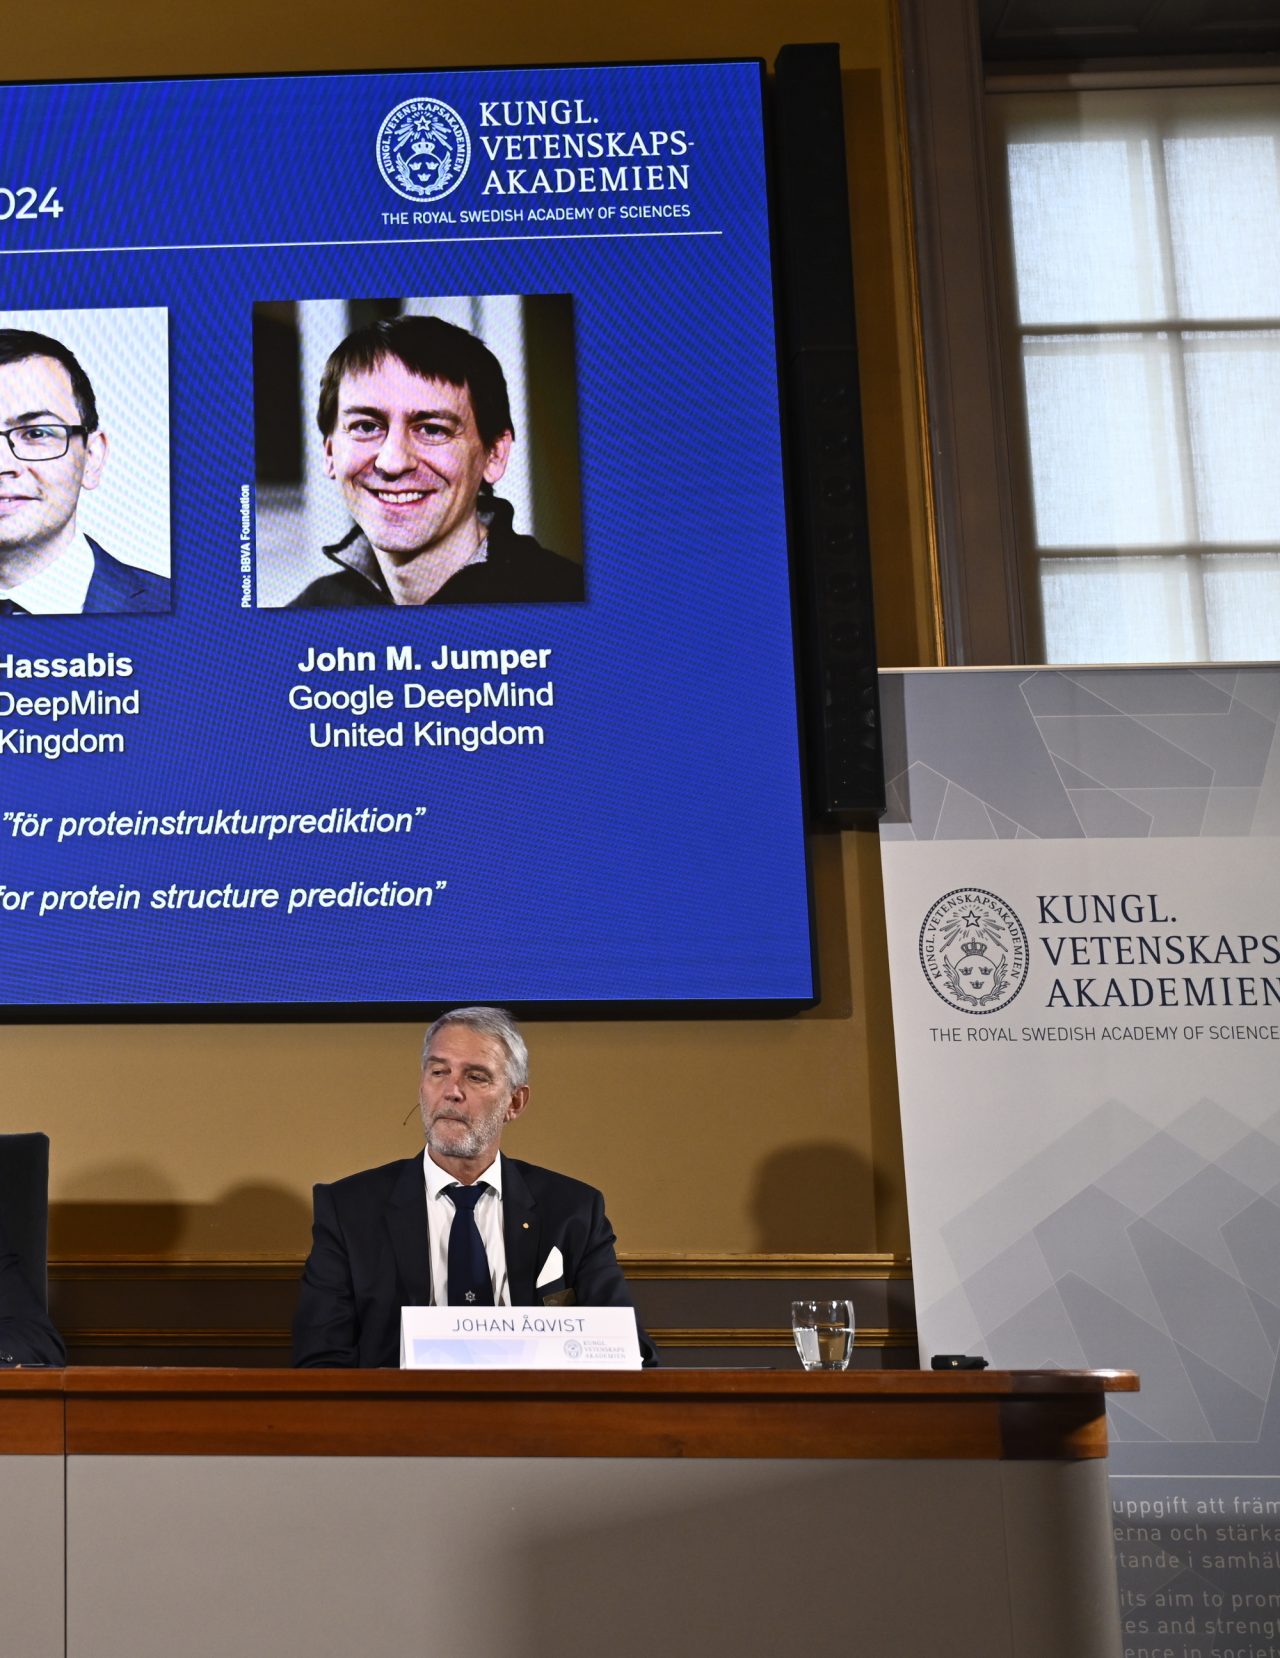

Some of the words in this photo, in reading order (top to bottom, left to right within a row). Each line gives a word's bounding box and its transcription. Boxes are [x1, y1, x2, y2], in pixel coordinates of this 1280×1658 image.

[480, 100, 598, 126] KUNGL.
[382, 134, 396, 174] KUNGL.
[480, 131, 694, 160] VETENSKAPS-
[482, 165, 689, 194] AKADEMIEN
[382, 213, 408, 224] THE
[414, 212, 456, 223] ROYAL
[460, 210, 523, 222] SWEDISH
[528, 208, 594, 220] ACADEMY
[598, 207, 615, 219] OF
[620, 205, 690, 218] SCIENCES
[240, 484, 250, 540] Foundation
[241, 542, 251, 572] BBVA
[241, 575, 251, 608] Photo:
[298, 647, 375, 672] John
[387, 646, 421, 670] M.
[432, 646, 551, 673] Jumper
[289, 685, 393, 714] Google
[405, 682, 553, 713] DeepMind
[0, 729, 123, 759] Kingdom
[310, 722, 403, 747] United
[415, 721, 543, 751] Kingdom
[40, 885, 140, 916] protein
[151, 884, 279, 908] structure
[1037, 895, 1176, 923] KUNGL.
[926, 932, 942, 979] KUNGL.
[1040, 935, 1280, 965] VETENSKAPS
[1046, 978, 1280, 1007] AKADEMIEN
[930, 1028, 961, 1041] THE
[968, 1028, 1017, 1041] ROYAL
[1022, 1027, 1095, 1041] SWEDISH
[1102, 1027, 1177, 1040] ACADEMY
[1184, 1026, 1203, 1040] OF
[454, 1319, 514, 1331] JOHAN
[522, 1315, 584, 1332] ÅQVIST
[1196, 1498, 1225, 1514] att
[1171, 1524, 1207, 1541] och
[1188, 1551, 1192, 1568] i
[1155, 1590, 1193, 1606] aim
[1203, 1591, 1223, 1607] to
[1158, 1616, 1195, 1634] and
